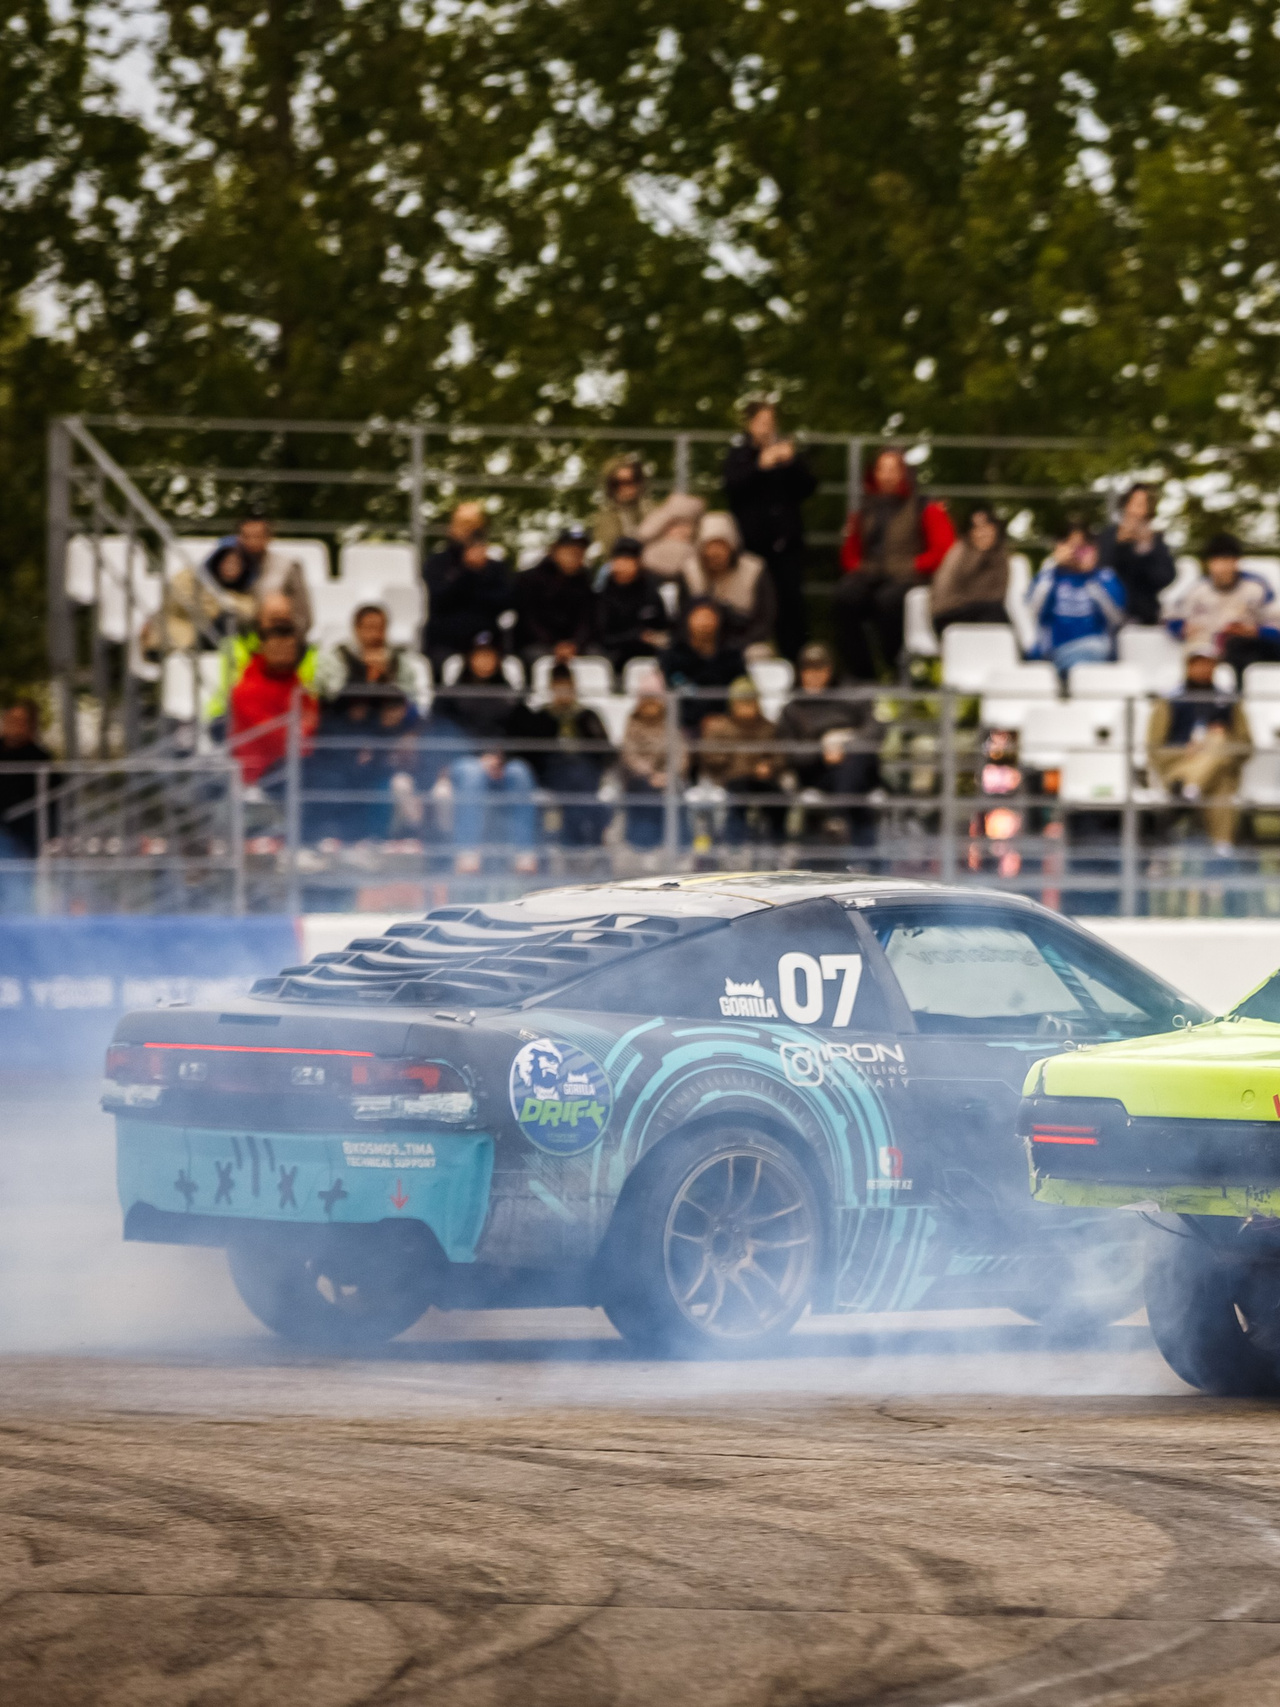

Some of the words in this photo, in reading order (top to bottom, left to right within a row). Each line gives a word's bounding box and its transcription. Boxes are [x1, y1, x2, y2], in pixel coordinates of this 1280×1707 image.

[778, 952, 863, 1027] 07
[719, 997, 778, 1018] GORILLA
[820, 1042, 905, 1063] IRON
[563, 1083, 596, 1096] GORILLA
[520, 1097, 605, 1130] DRIFT
